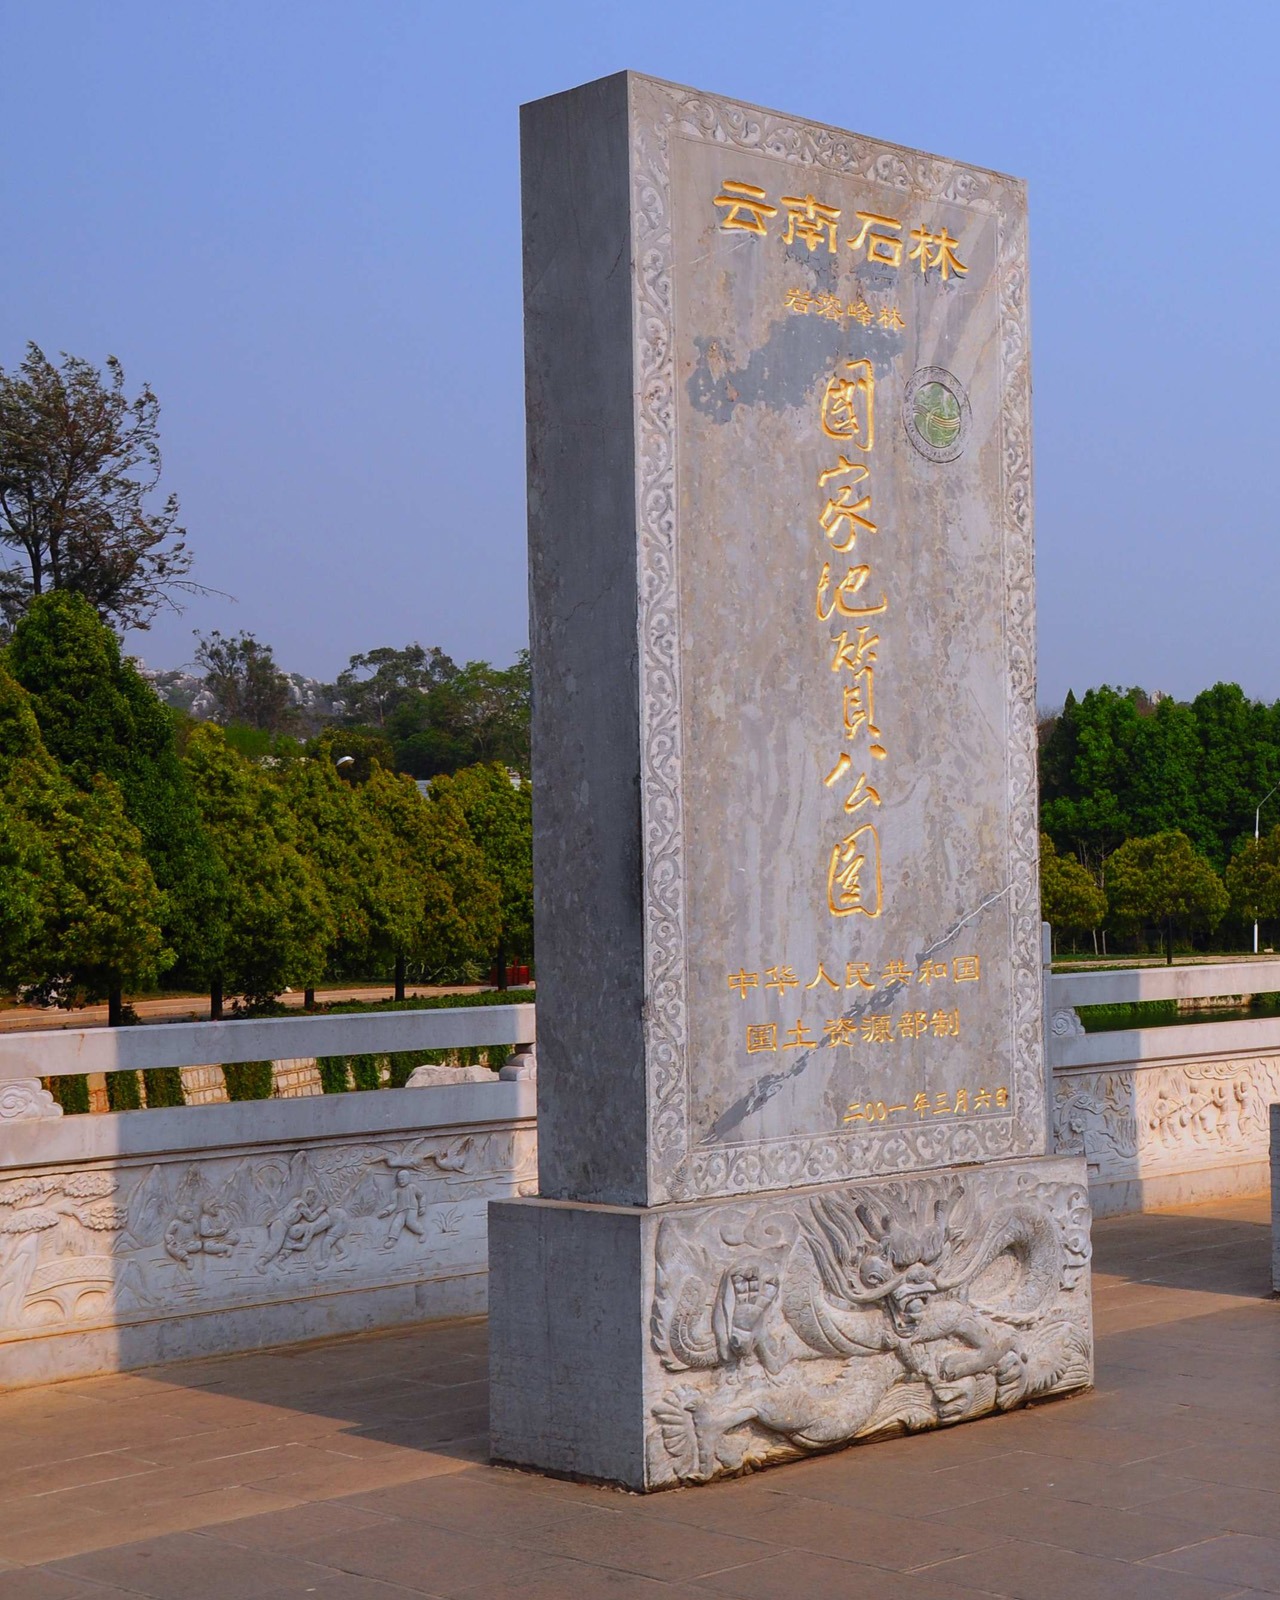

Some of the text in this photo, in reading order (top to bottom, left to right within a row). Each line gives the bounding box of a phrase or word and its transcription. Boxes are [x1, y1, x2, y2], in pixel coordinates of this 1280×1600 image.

[714, 180, 969, 281] 云南石林
[728, 955, 981, 999] 中华人民共和国
[746, 1008, 960, 1053] 国土资源部制
